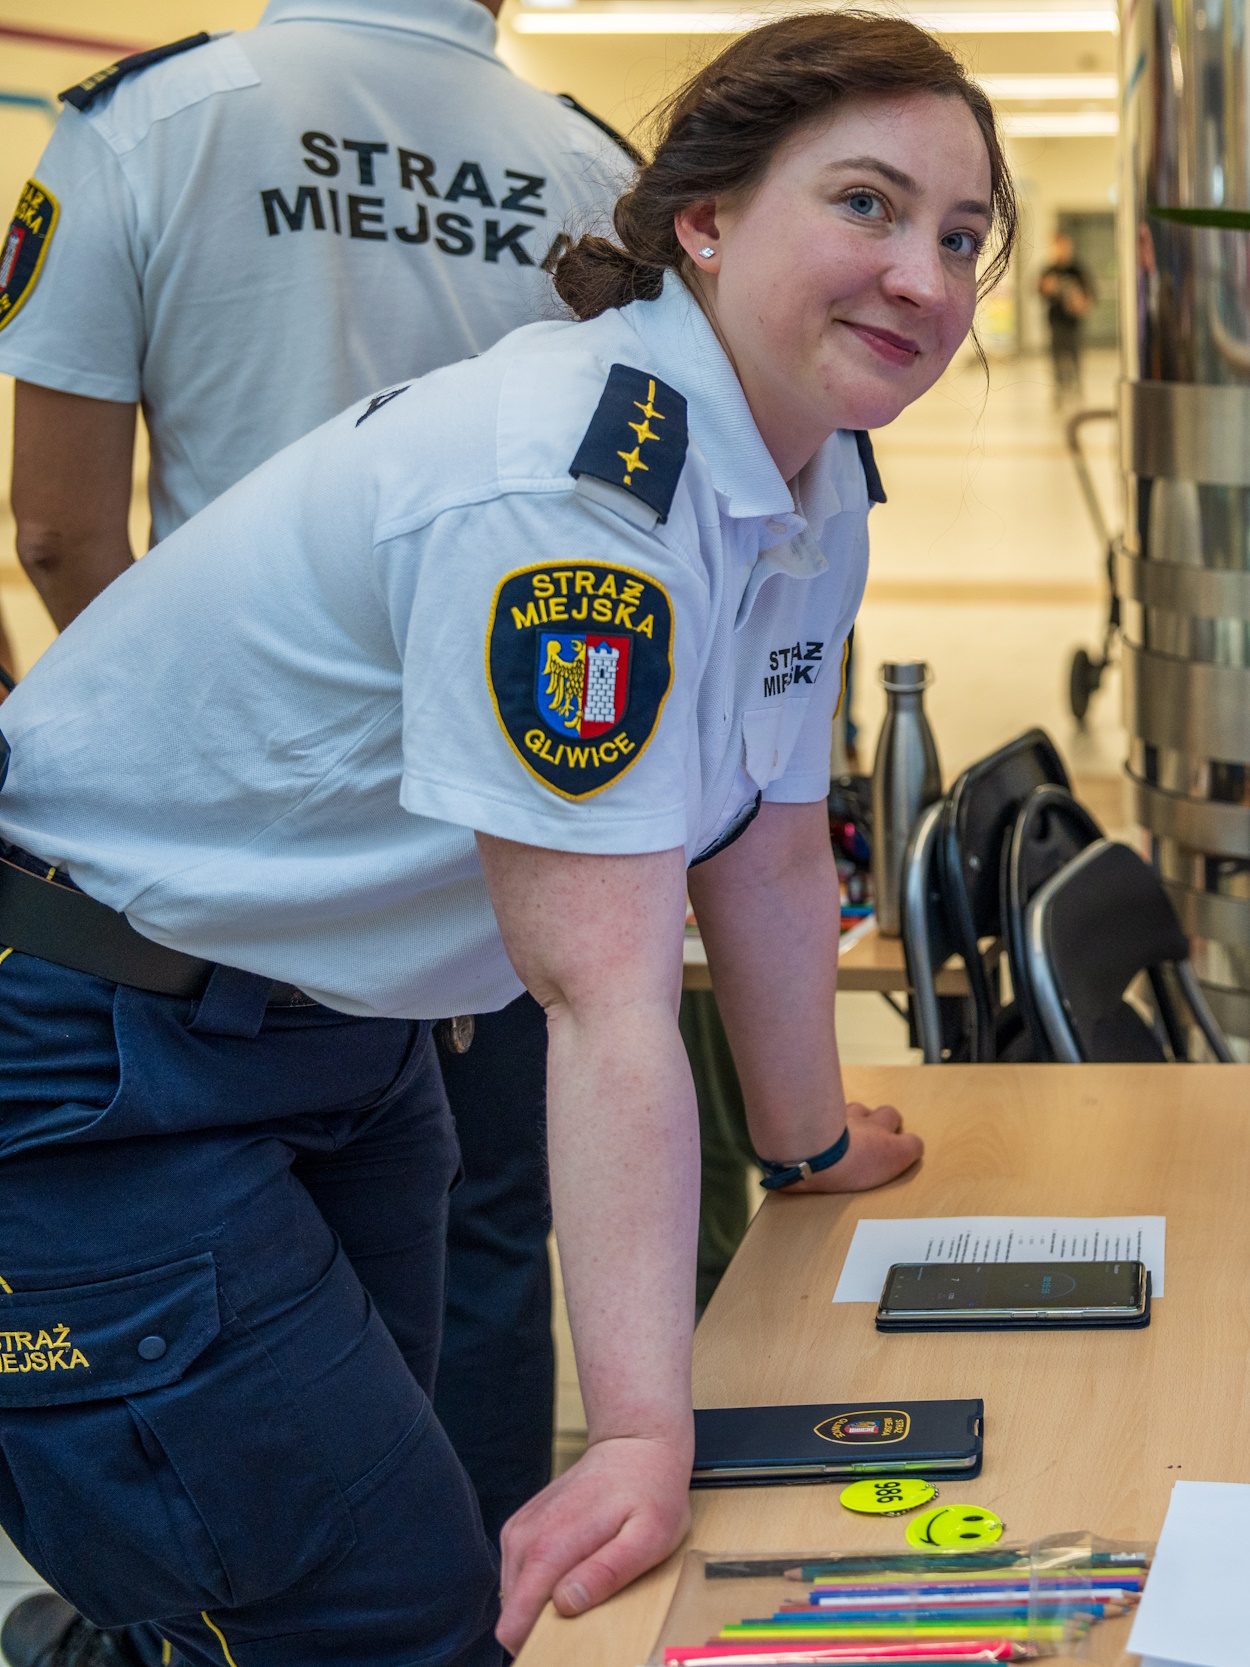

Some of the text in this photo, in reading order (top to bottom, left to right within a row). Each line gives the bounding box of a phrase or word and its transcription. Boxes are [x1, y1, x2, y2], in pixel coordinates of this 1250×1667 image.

[532, 570, 645, 606] STRAŻ
[511, 597, 654, 639] MIEJSKA
[524, 729, 635, 768] GLIWICE
[874, 1481, 903, 1504] 986
